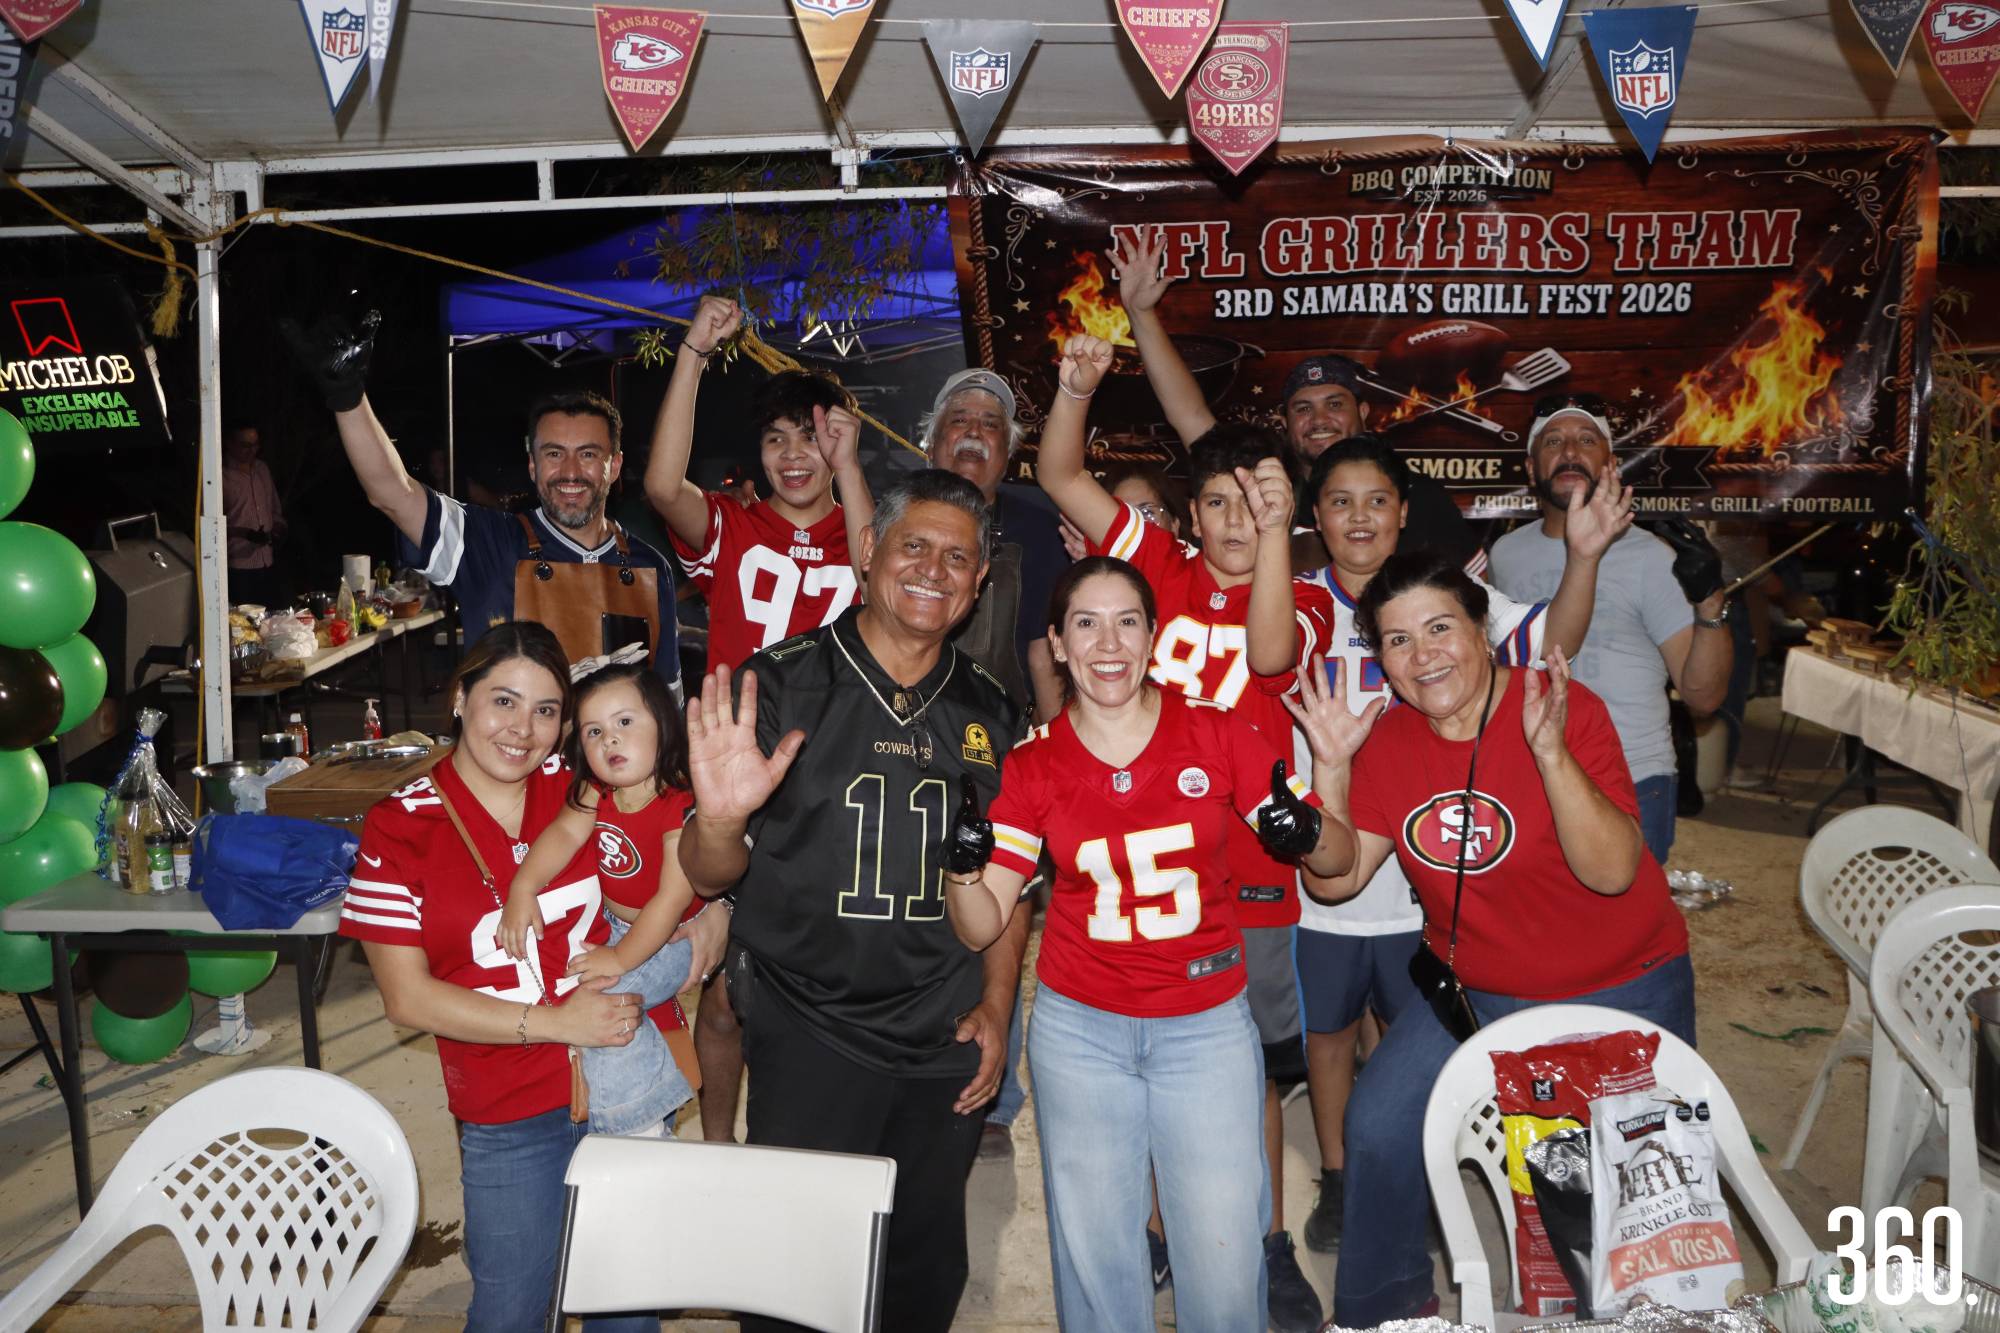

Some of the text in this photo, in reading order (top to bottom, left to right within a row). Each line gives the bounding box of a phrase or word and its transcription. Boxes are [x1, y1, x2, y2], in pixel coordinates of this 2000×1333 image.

[608, 16, 690, 37] KANSAS CITY
[1127, 7, 1210, 28] CHIEFS
[325, 31, 360, 57] NFL
[1936, 45, 2000, 66] CHIEFS
[1207, 55, 1260, 71] SAN FRANCISCO
[610, 76, 677, 96] CHIEFS
[957, 69, 1002, 90] NFL
[1618, 76, 1668, 107] NFL
[1217, 88, 1252, 98] 49ERS
[1195, 103, 1274, 127] 49ERS
[1352, 164, 1552, 192] BBQ COMPETITION
[1414, 190, 1487, 202] EST 2026
[1259, 213, 1590, 276] GRILLERS
[1608, 210, 1801, 272] TEAM
[1214, 289, 1274, 318] 3RD
[1442, 283, 1529, 314] GRILL
[1538, 284, 1612, 314] FEST
[1619, 282, 1692, 312] 2026
[0, 355, 135, 391] MICHELOB
[22, 391, 129, 414] EXCELENCIA
[1405, 458, 1502, 480] SMOKE
[1630, 497, 1691, 512] SMOKE
[1711, 497, 1762, 512] GRILL
[1783, 497, 1874, 513] FOOTBALL
[788, 546, 824, 561] 49ERS
[738, 544, 857, 654] 97
[1151, 615, 1251, 710] 87
[874, 741, 931, 759] COWBOS
[838, 772, 948, 921] 11
[1075, 822, 1201, 943] 15
[469, 875, 602, 1006] 97
[1618, 1112, 1666, 1133] KIRKLAND
[1639, 1192, 1683, 1217] BRAND
[1620, 1207, 1686, 1241] KRINKLE
[1620, 1234, 1732, 1283] SAL ROSA
